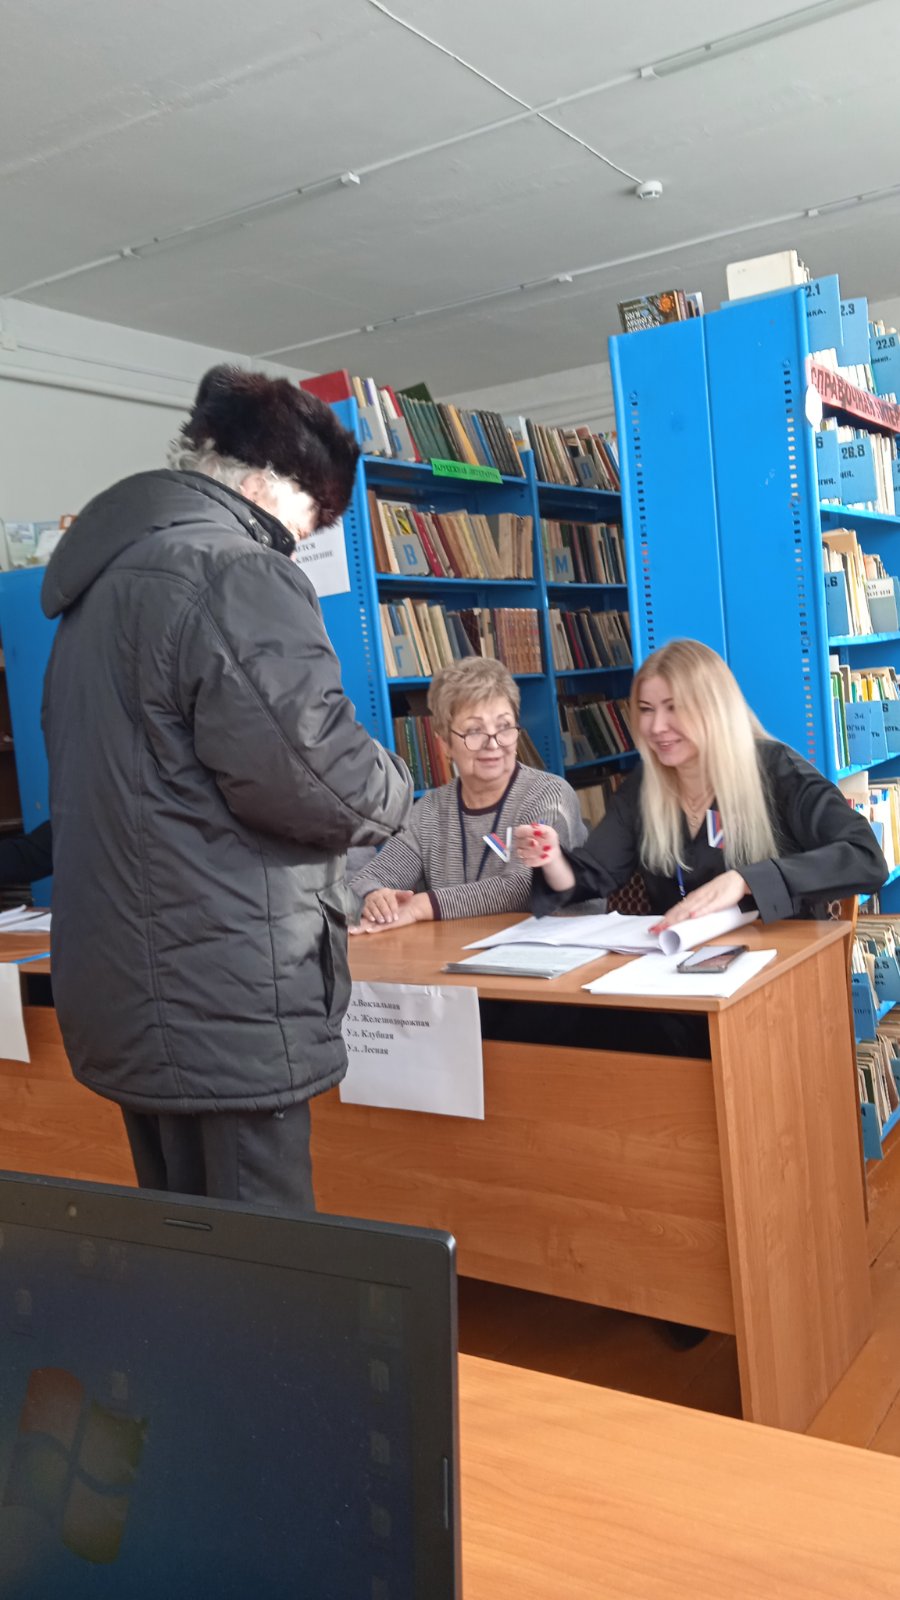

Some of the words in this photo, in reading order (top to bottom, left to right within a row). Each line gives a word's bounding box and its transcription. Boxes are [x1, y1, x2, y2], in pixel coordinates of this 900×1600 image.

[804, 283, 820, 298] 2.1
[811, 367, 876, 418] СПРАВОЧНАЯ
[815, 436, 824, 449] 6
[403, 543, 418, 565] В
[555, 555, 568, 573] М
[824, 576, 838, 588] .6
[351, 999, 401, 1011] л.Вокзальная
[361, 1014, 430, 1028] Железнодорожная
[361, 1030, 394, 1041] Клубная
[361, 1045, 389, 1056] Лесная
